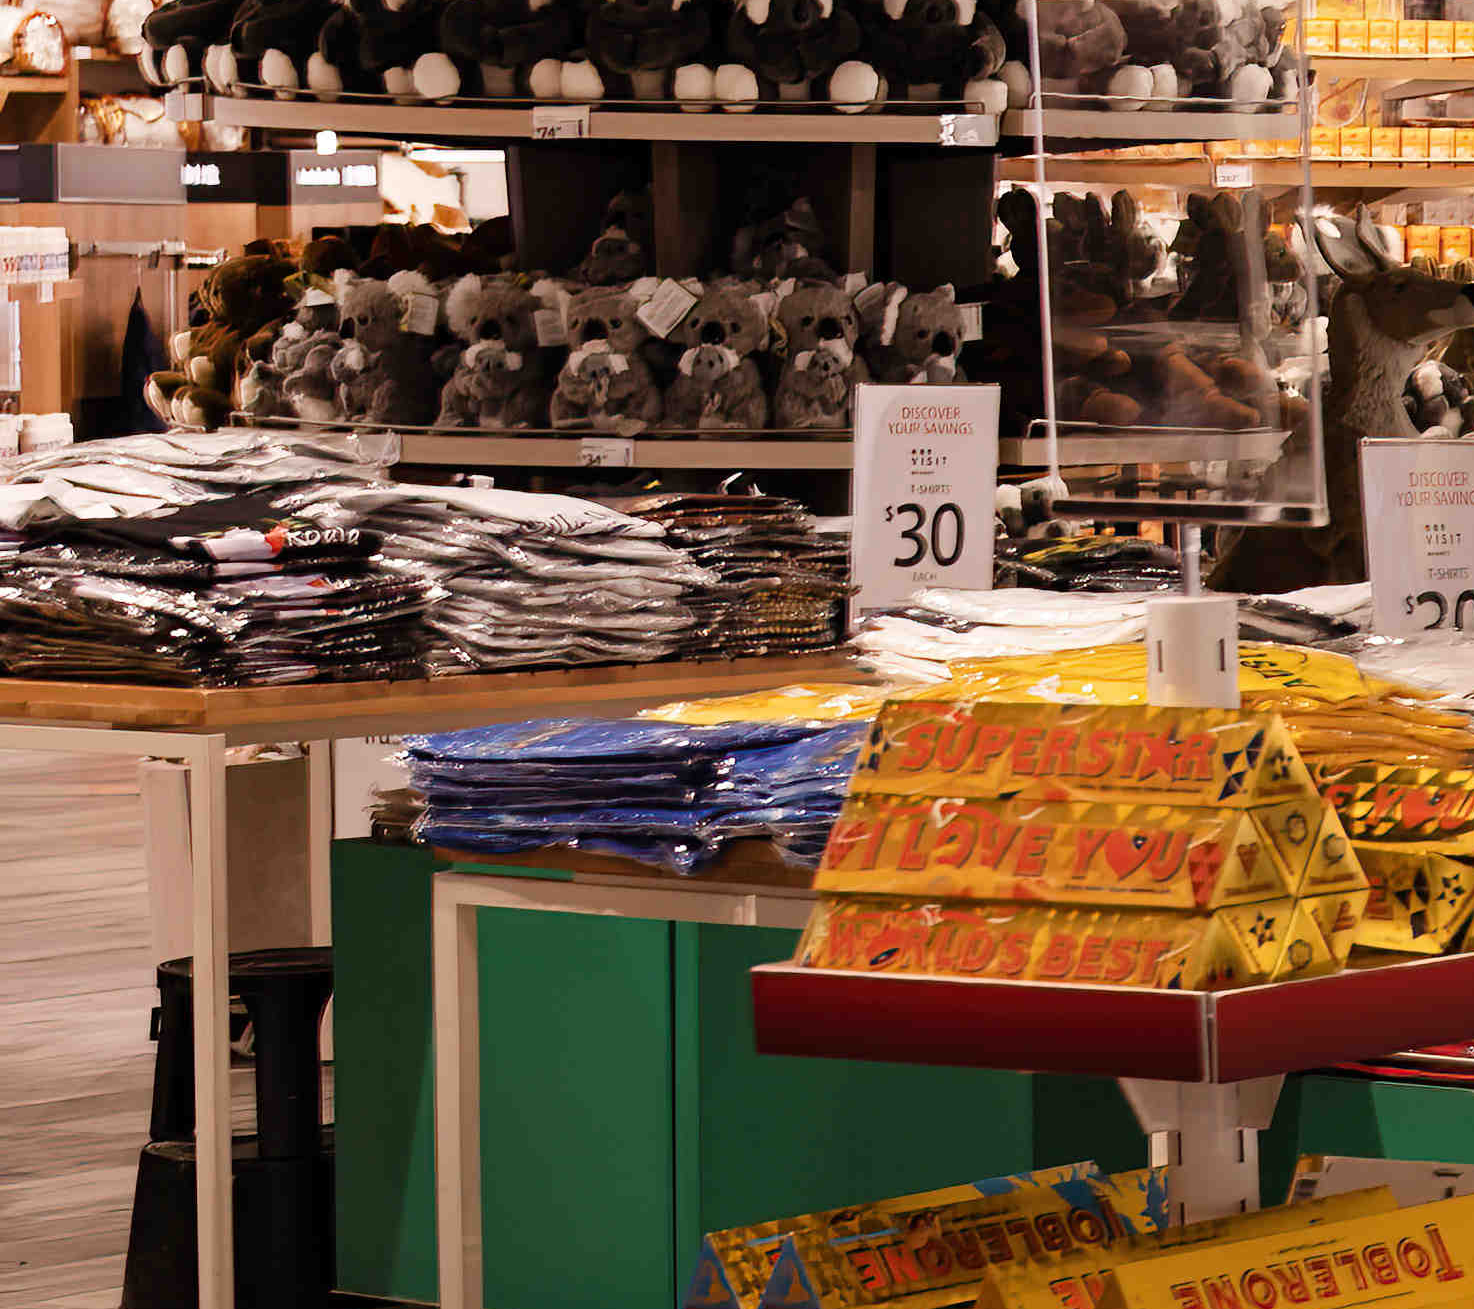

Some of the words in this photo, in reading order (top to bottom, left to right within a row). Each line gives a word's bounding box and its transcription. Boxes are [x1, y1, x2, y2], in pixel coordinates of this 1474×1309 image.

[901, 406, 961, 420] DISCOVER
[888, 422, 921, 435] YOUR
[923, 422, 975, 435] SAVINGS
[1408, 471, 1469, 488] DISCOVER
[894, 820, 1049, 879] LOVE
[1040, 925, 1172, 980] BEST
